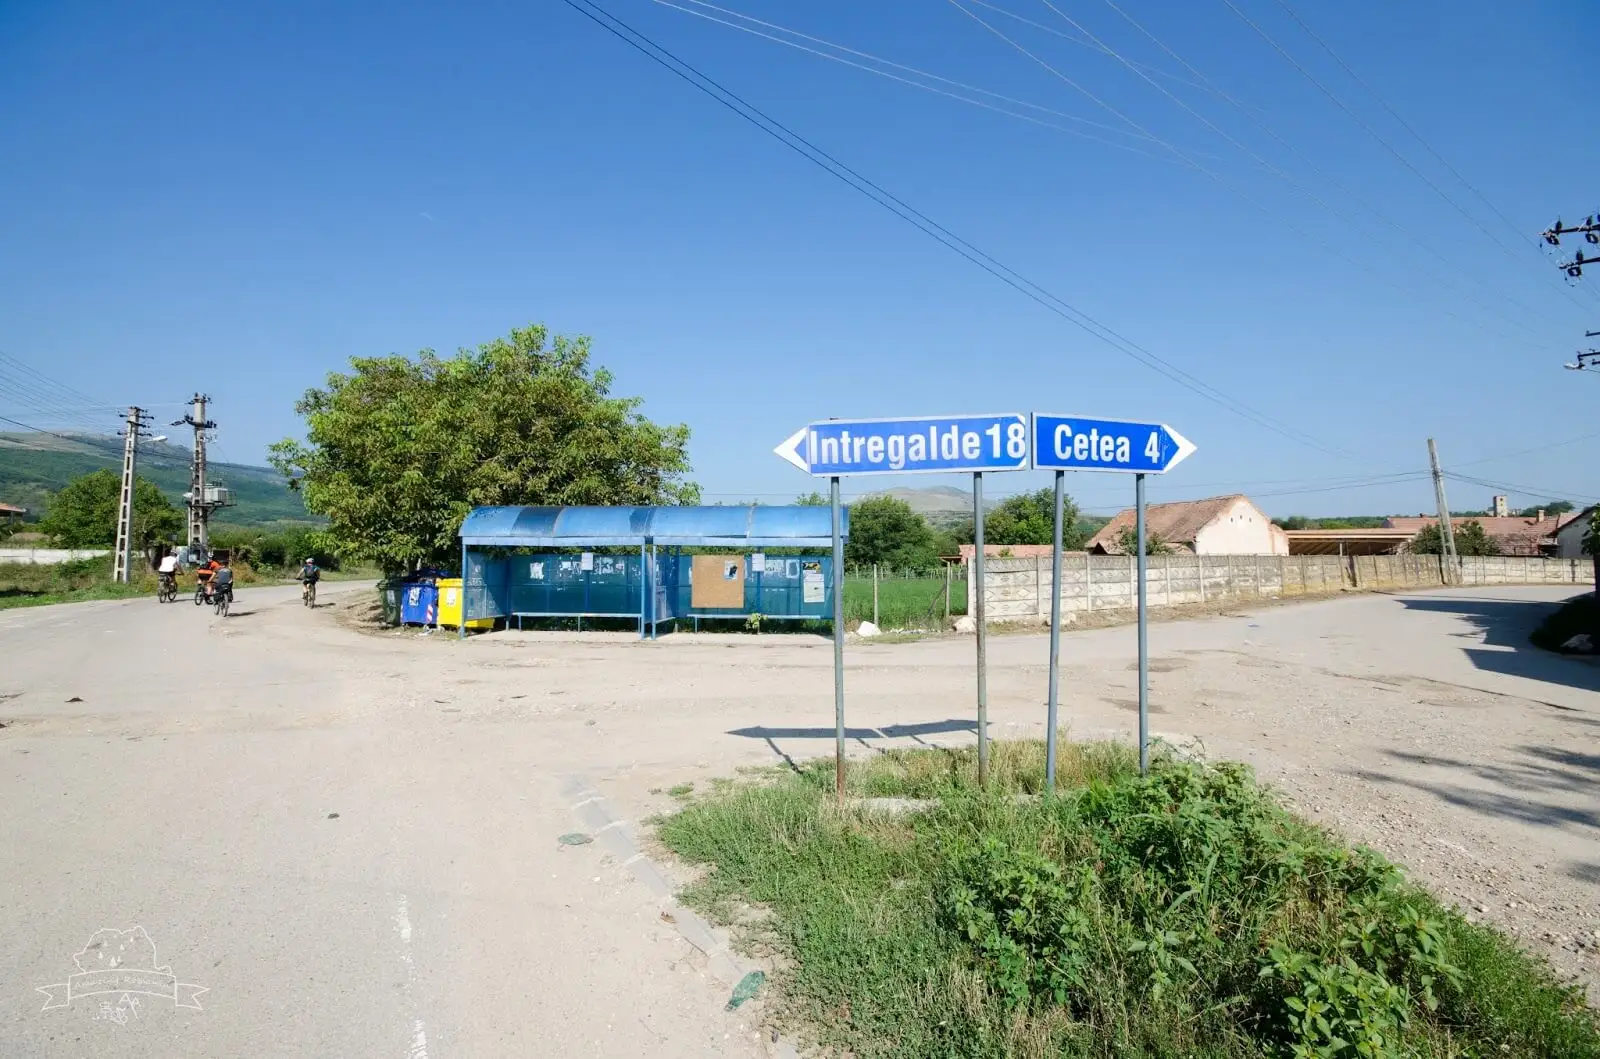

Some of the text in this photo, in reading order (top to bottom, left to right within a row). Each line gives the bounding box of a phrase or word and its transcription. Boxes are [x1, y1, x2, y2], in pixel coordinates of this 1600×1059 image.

[810, 422, 1026, 470] Intregalde 18
[1054, 423, 1161, 464] Cetea 4
